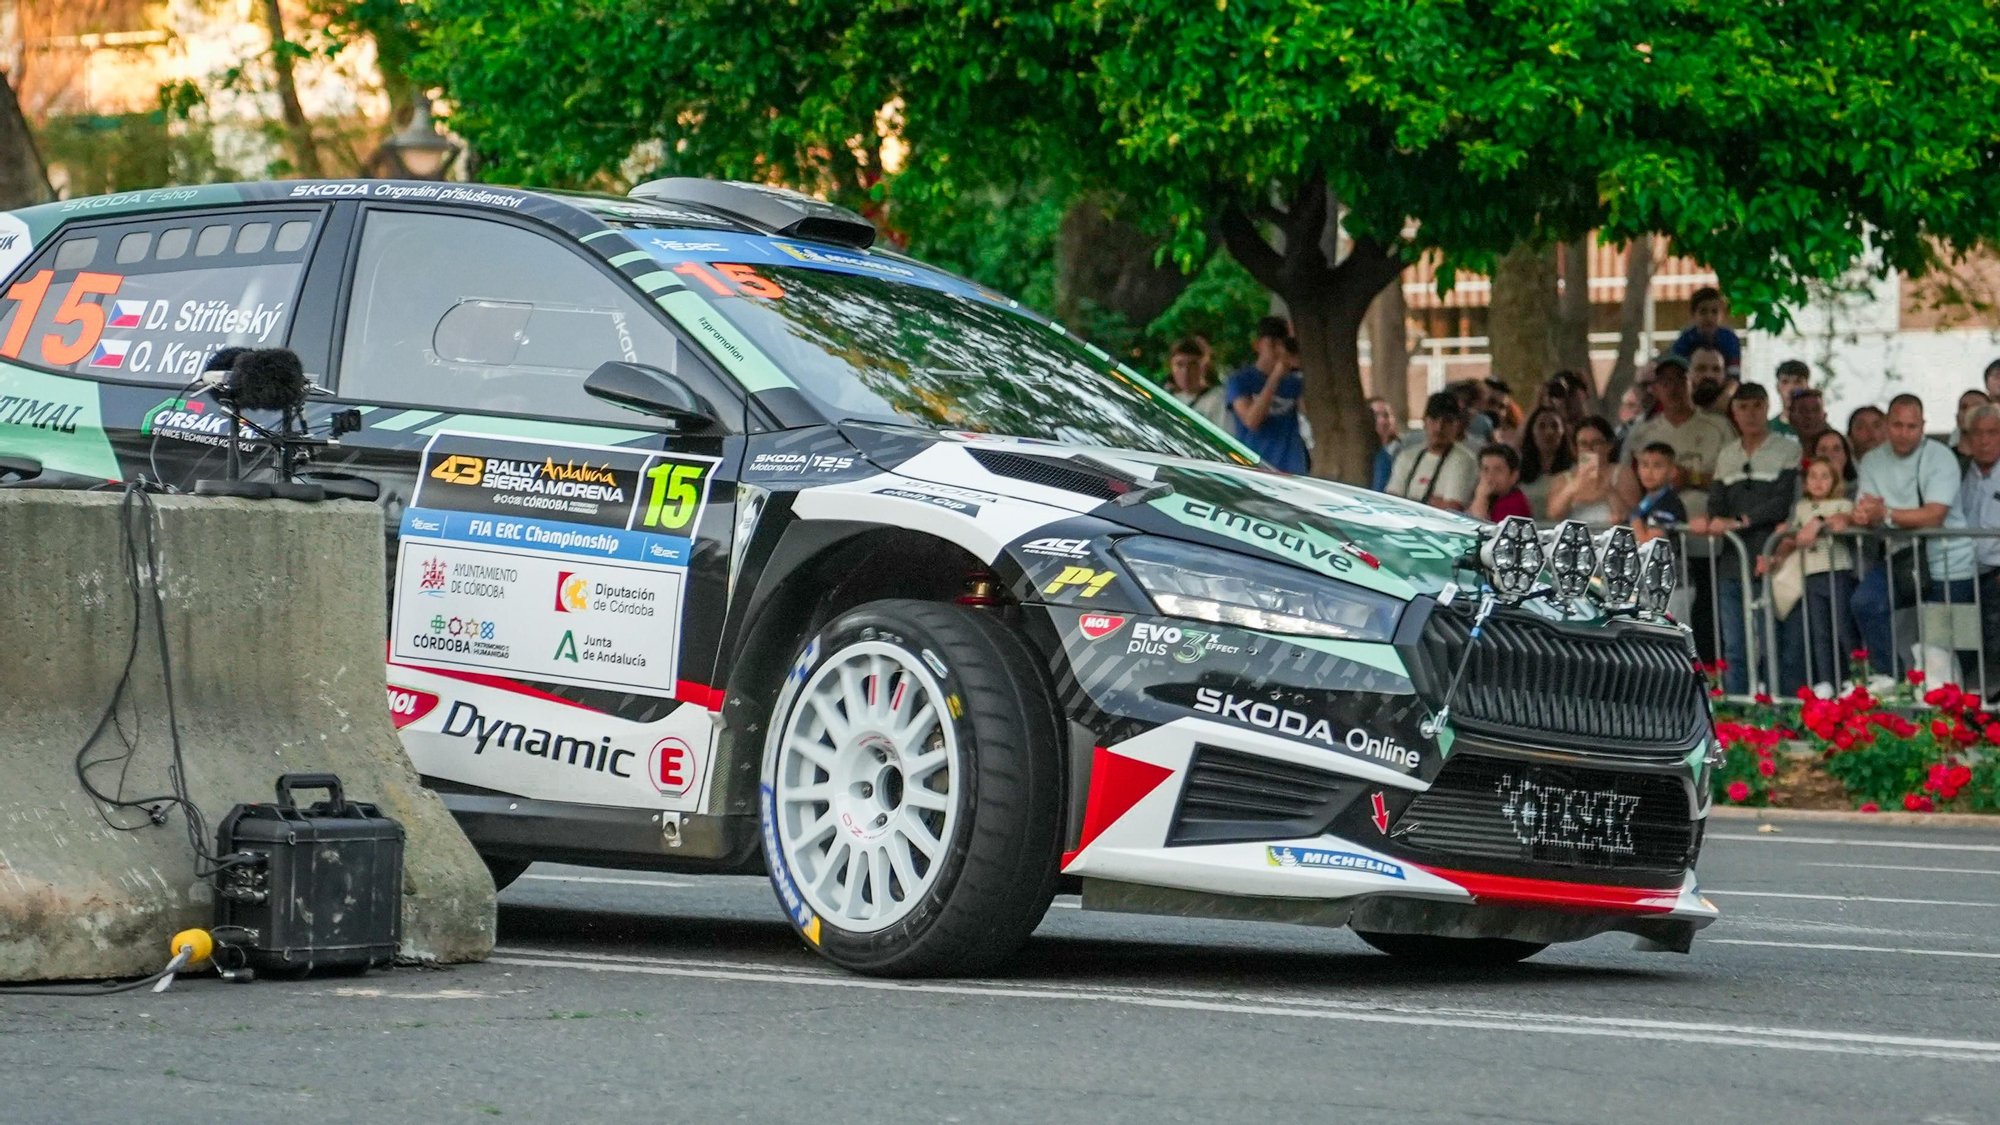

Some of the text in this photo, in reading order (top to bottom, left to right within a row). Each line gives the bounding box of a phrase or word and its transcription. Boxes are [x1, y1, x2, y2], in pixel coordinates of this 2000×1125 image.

[146, 189, 198, 203] E-shop
[374, 184, 442, 199] Originální
[437, 186, 525, 208] příslušenství
[673, 262, 785, 299] 15
[1, 269, 125, 366] 15
[145, 300, 284, 343] D. Stříteský
[612, 312, 638, 363] SKOD
[129, 341, 225, 382] O. Kraj
[154, 411, 229, 434] ORSÁK
[218, 438, 256, 453] KOROLY
[430, 454, 484, 486] 43
[485, 457, 617, 487] RALLY Andalucía
[749, 462, 801, 471] Motorsport
[813, 455, 854, 469] 125
[482, 474, 624, 503] SIERRA MORENA
[643, 462, 704, 529] 15
[523, 494, 568, 511] CÓRDOBA
[932, 498, 967, 510] Cup
[468, 519, 619, 555] FIA ERC Championship
[1182, 501, 1353, 573] Emotive
[452, 563, 518, 583] AYUNTAMIENTO
[1043, 566, 1118, 598] P1
[451, 580, 505, 599] DE CÓRDOBA
[595, 582, 655, 602] Diputación
[593, 599, 654, 617] de Córdoba
[1084, 617, 1110, 628] MOL
[413, 633, 471, 653] CÓRDOBA
[584, 634, 612, 649] Junta
[1126, 638, 1168, 655] plus
[1131, 622, 1182, 644] EVO
[1173, 629, 1210, 664] 3
[1205, 643, 1240, 654] EFFECT
[583, 649, 646, 667] de Andalucía
[441, 700, 684, 786] Dynamic E
[1345, 728, 1420, 768] Online
[1302, 852, 1398, 875] MICHELIN
